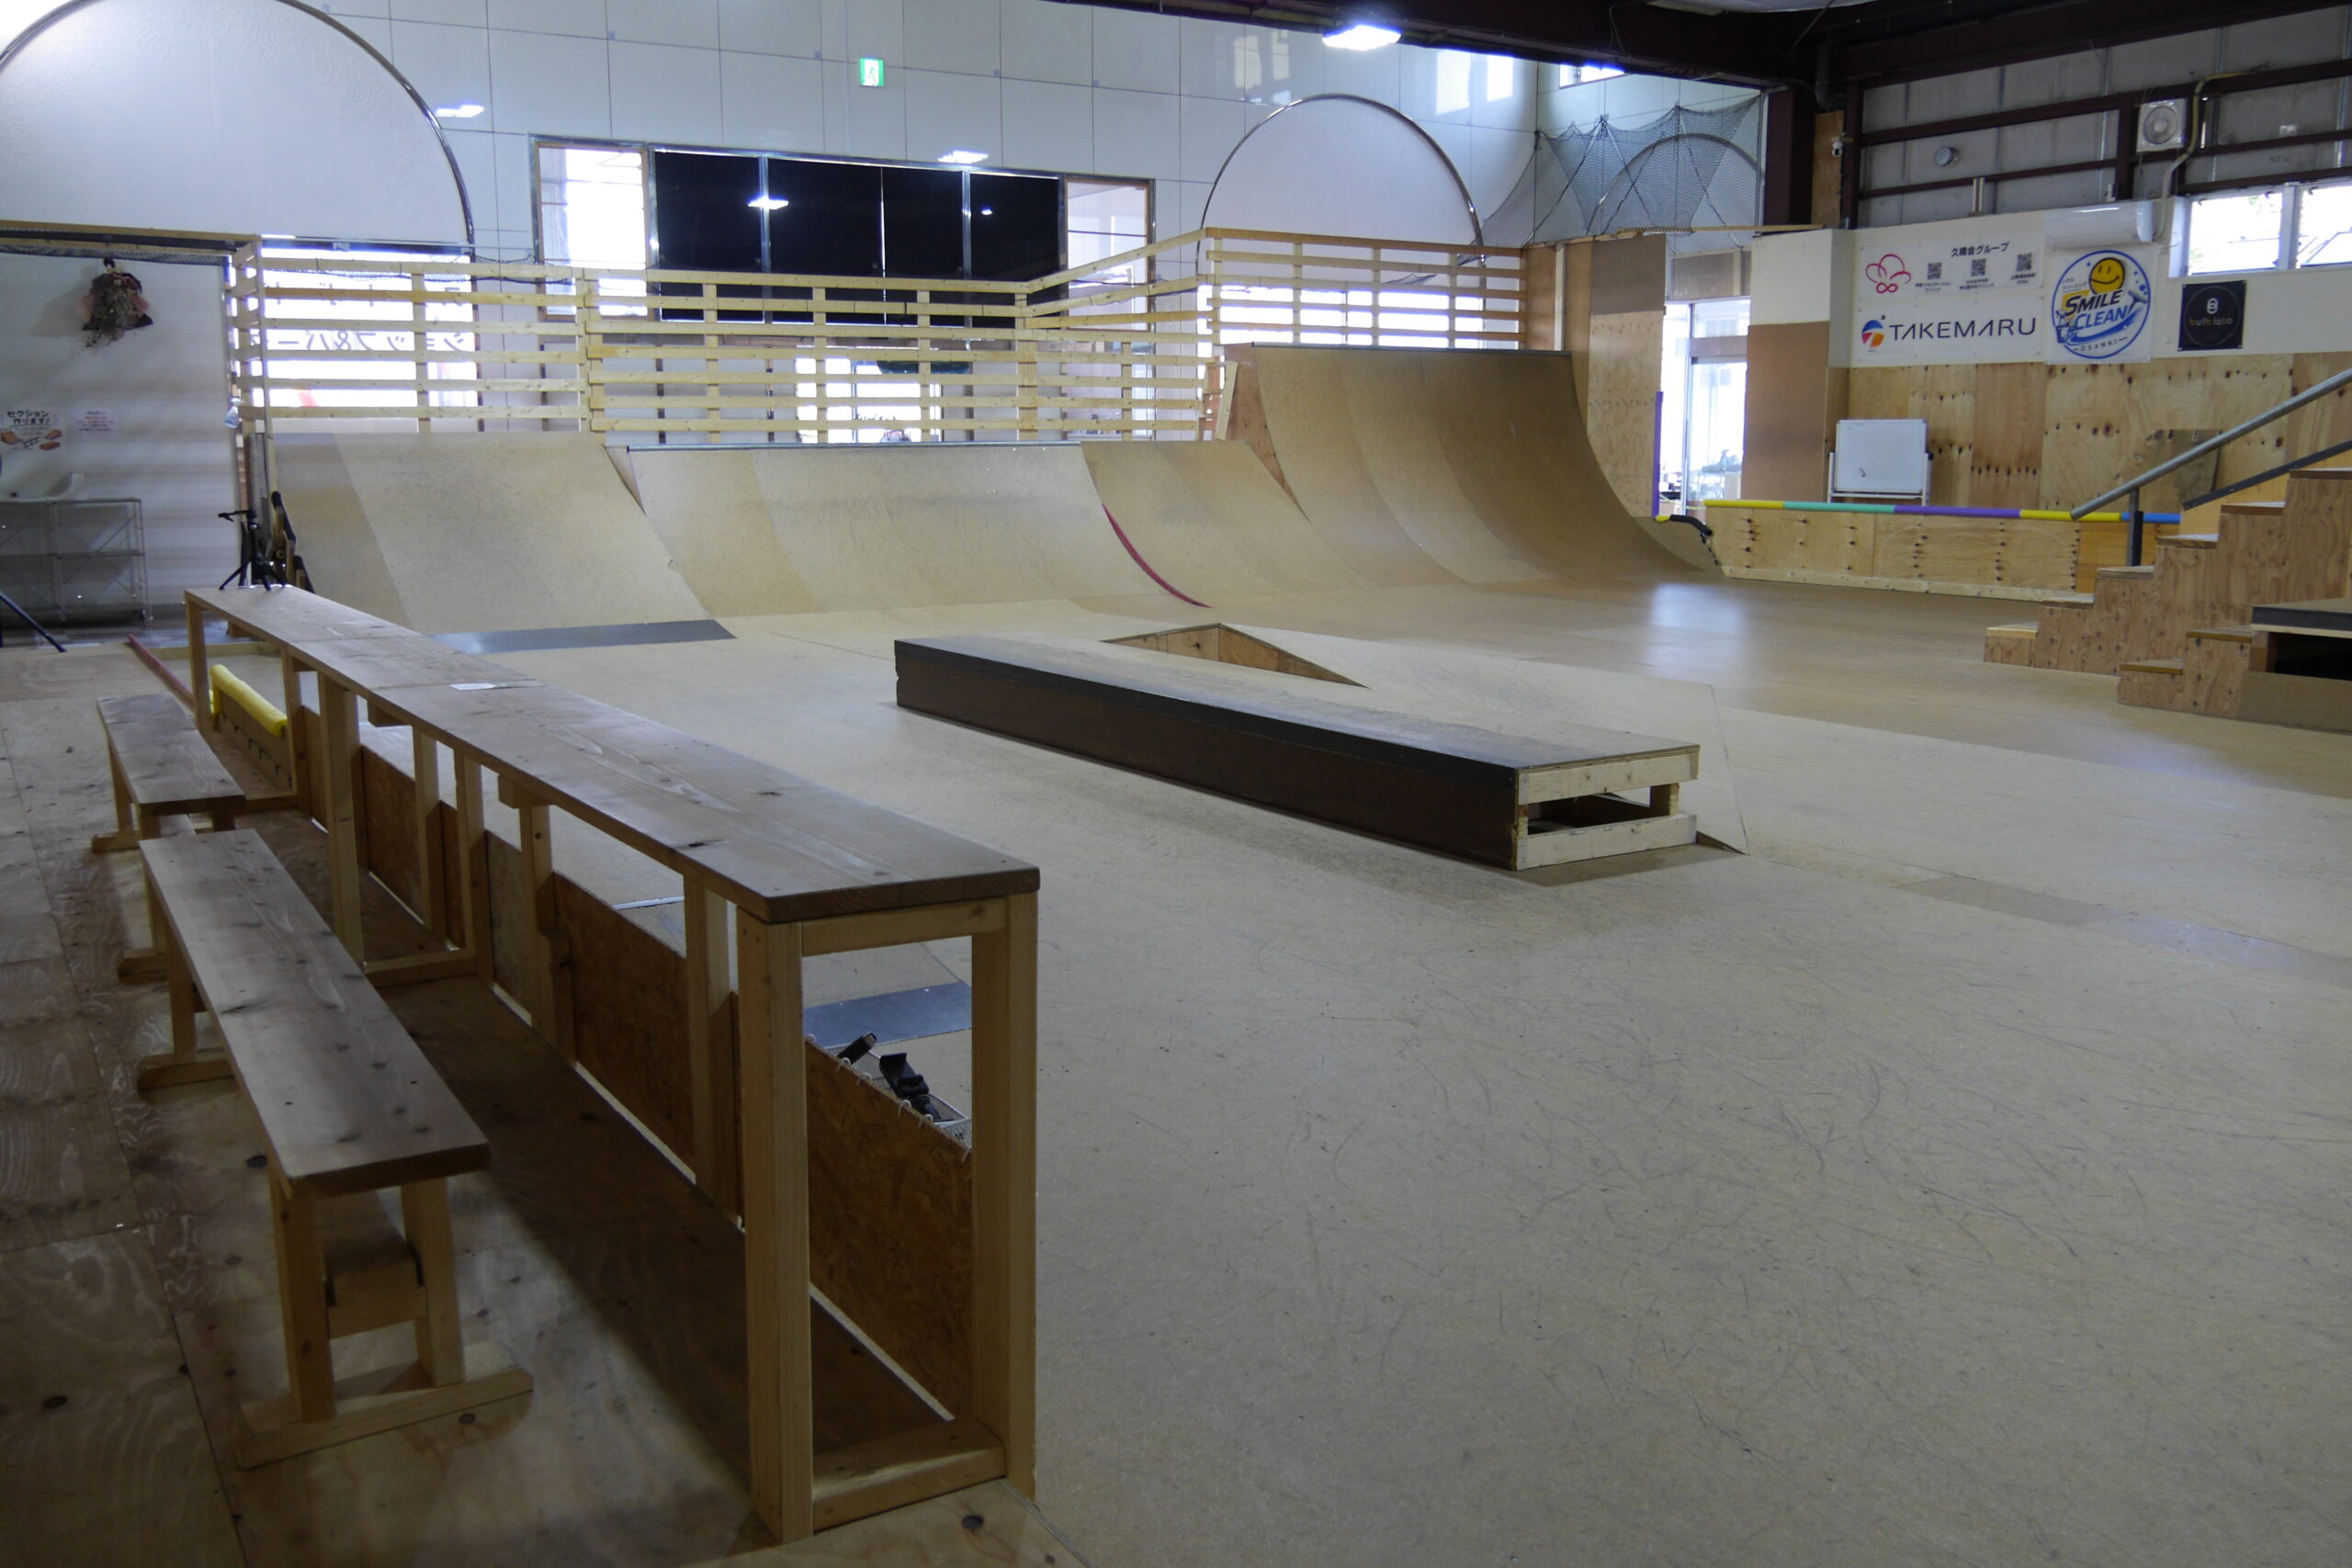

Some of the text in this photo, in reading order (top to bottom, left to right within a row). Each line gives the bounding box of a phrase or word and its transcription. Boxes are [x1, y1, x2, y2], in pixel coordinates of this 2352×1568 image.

[2065, 289, 2123, 317] SMILE
[1889, 317, 2036, 341] TAKEMARU
[2075, 305, 2129, 331] CLEAN
[6, 410, 50, 419] セクション
